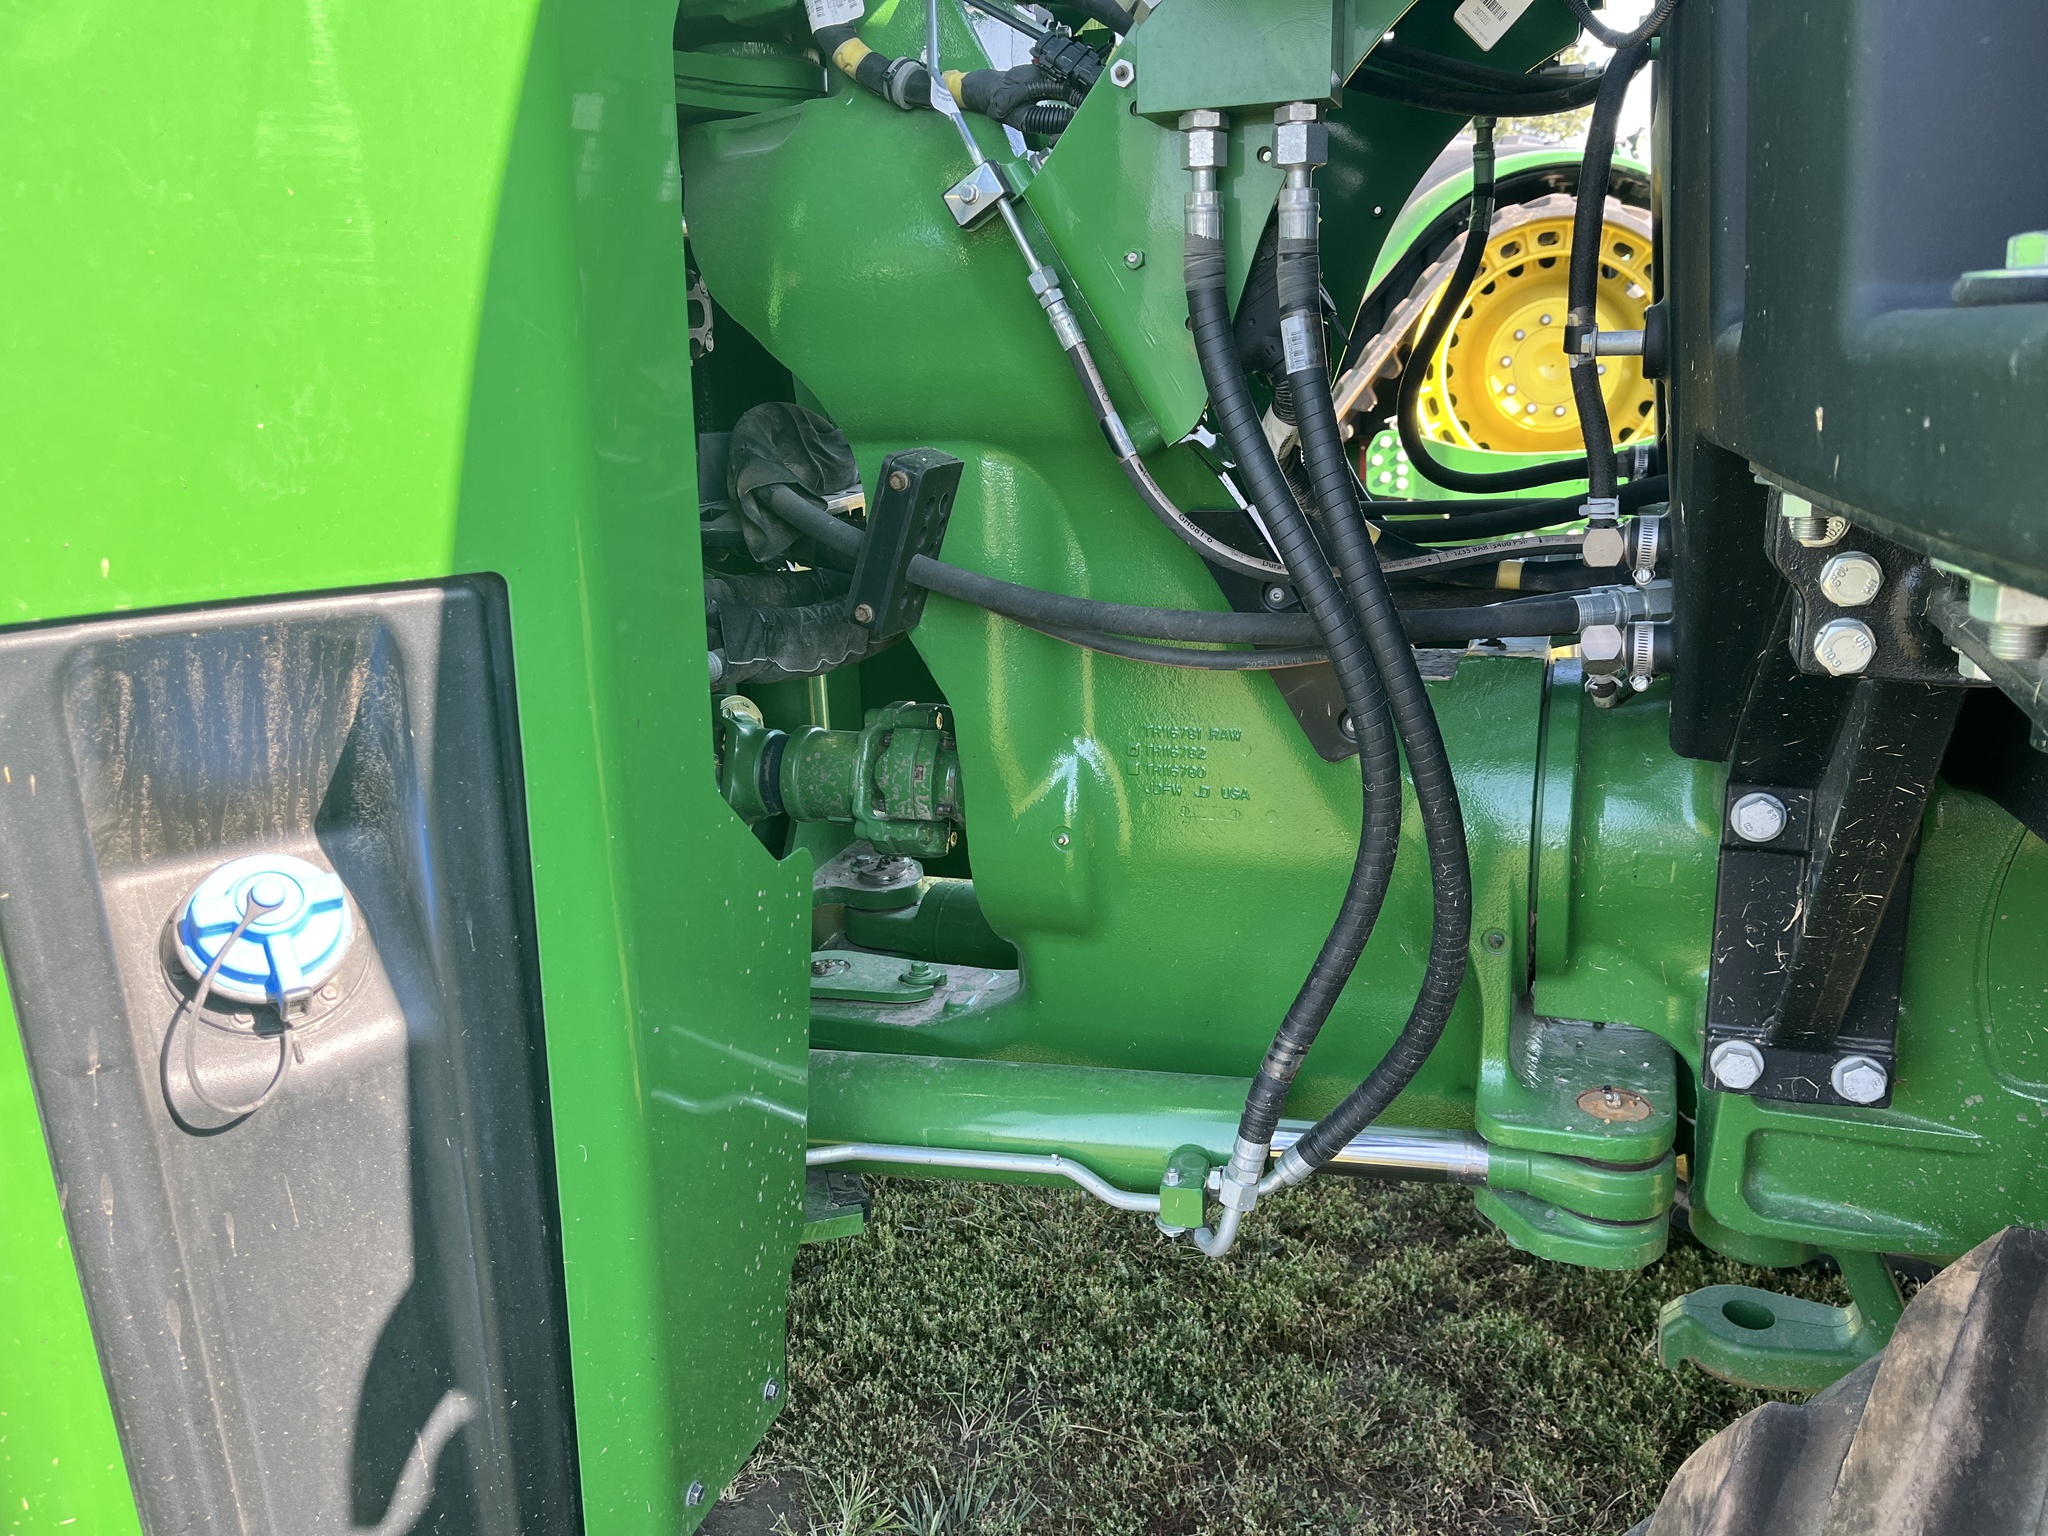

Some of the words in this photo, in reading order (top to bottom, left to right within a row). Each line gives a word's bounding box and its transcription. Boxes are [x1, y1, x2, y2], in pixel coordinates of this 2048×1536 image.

[1826, 520, 1844, 540] 10.9
[1246, 656, 1303, 669] 2023-11-08
[1824, 647, 1842, 669] 10.9
[1208, 727, 1243, 742] RAW
[1193, 785, 1211, 799] JD
[1221, 786, 1251, 801] USA
